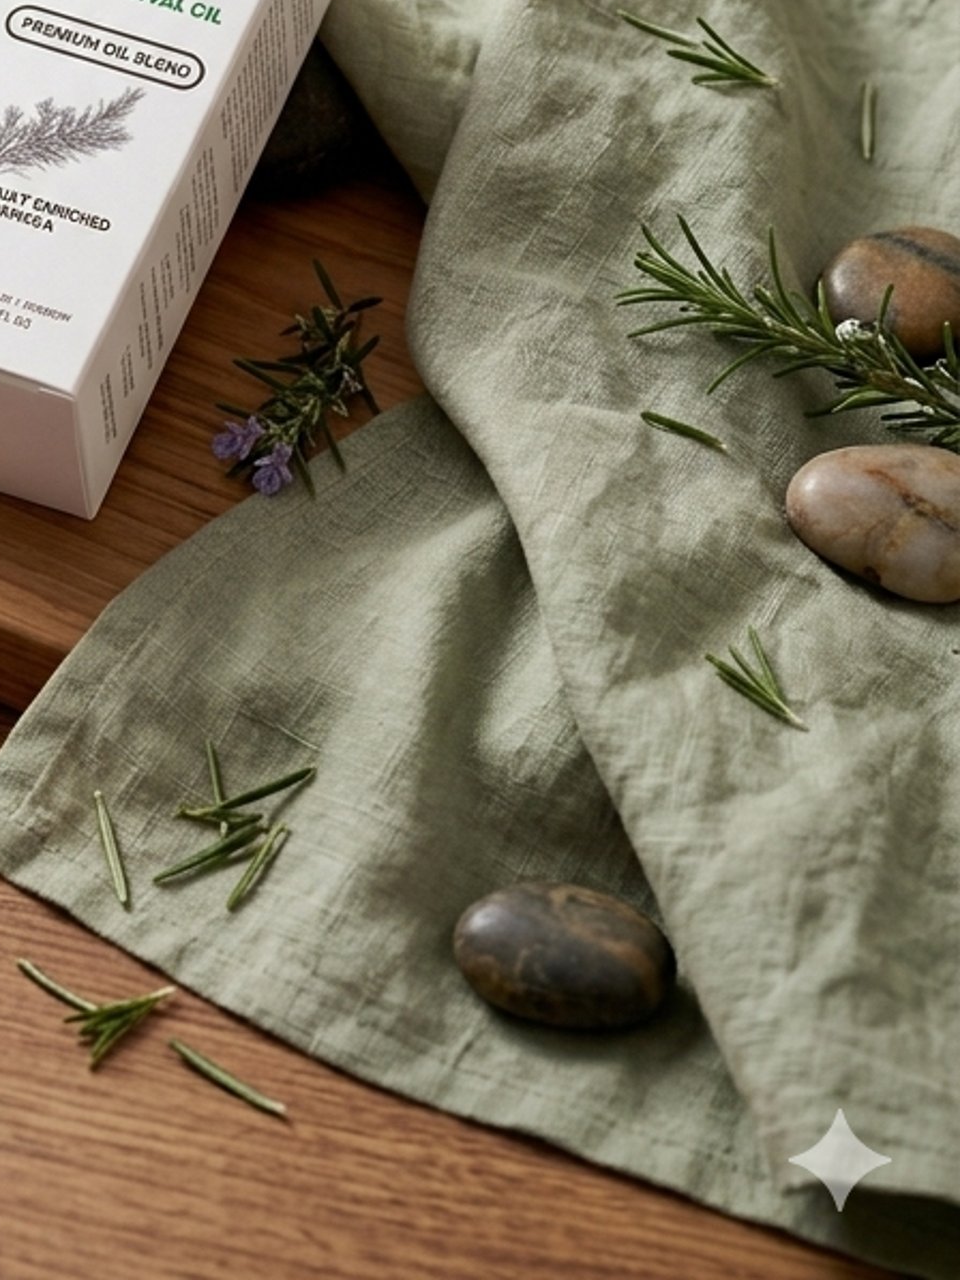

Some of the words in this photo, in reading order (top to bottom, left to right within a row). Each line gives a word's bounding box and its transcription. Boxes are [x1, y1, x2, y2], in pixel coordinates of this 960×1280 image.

[190, 2, 222, 25] OIL
[20, 17, 101, 51] PREMIUM
[102, 42, 129, 61] OIL
